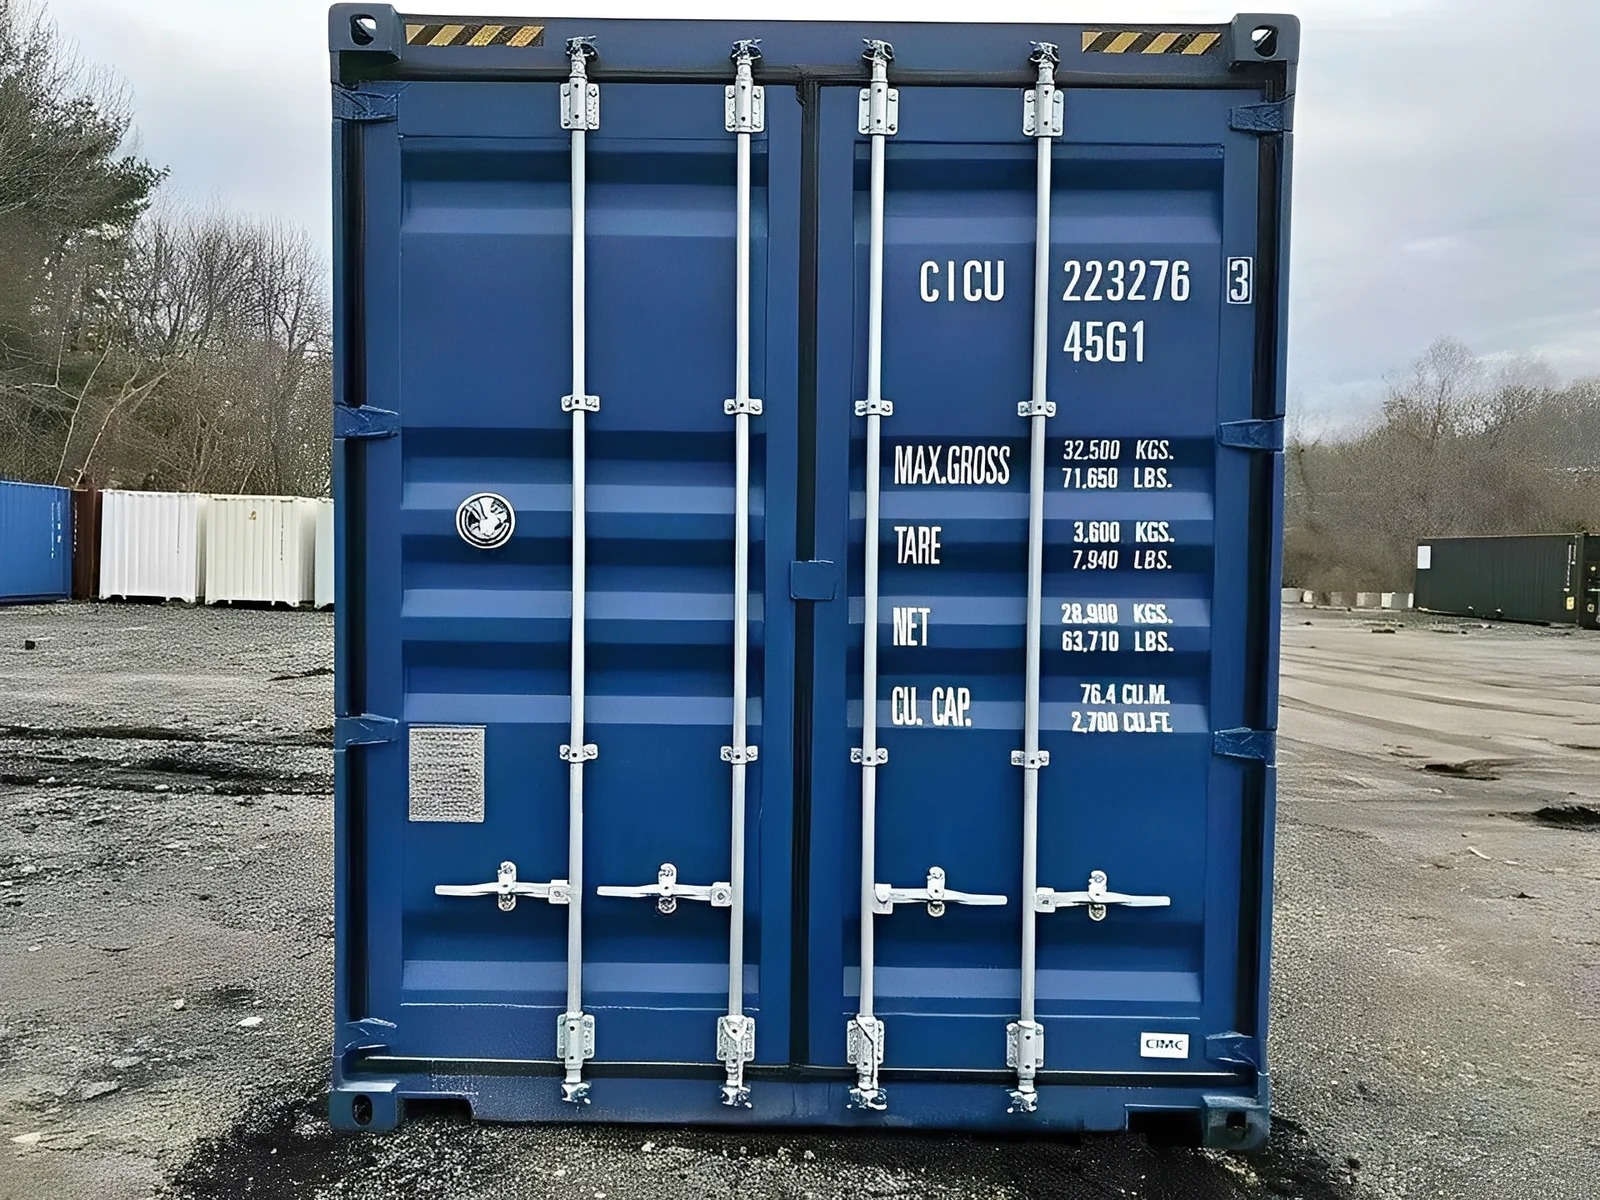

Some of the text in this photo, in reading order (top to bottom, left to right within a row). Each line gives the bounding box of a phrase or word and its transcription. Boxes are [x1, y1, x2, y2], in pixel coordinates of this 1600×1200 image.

[921, 259, 1249, 302] CICU 223276 3
[1063, 320, 1144, 362] 45G1
[1135, 439, 1174, 460] KGS.
[894, 445, 1011, 485] MAX.GROSS
[1062, 467, 1173, 489] 71,650 LBS.
[1073, 521, 1175, 543] 3,600 KGS.
[894, 526, 942, 565] TARE
[1072, 549, 1173, 570] 7,940 LBS.
[1133, 603, 1174, 624] KGS.
[892, 606, 931, 646] NET
[1062, 630, 1174, 653] 63,710 LBS.
[1080, 683, 1116, 705] 76.4
[891, 686, 972, 727] CU. CAP.
[1071, 710, 1119, 734] 2,700
